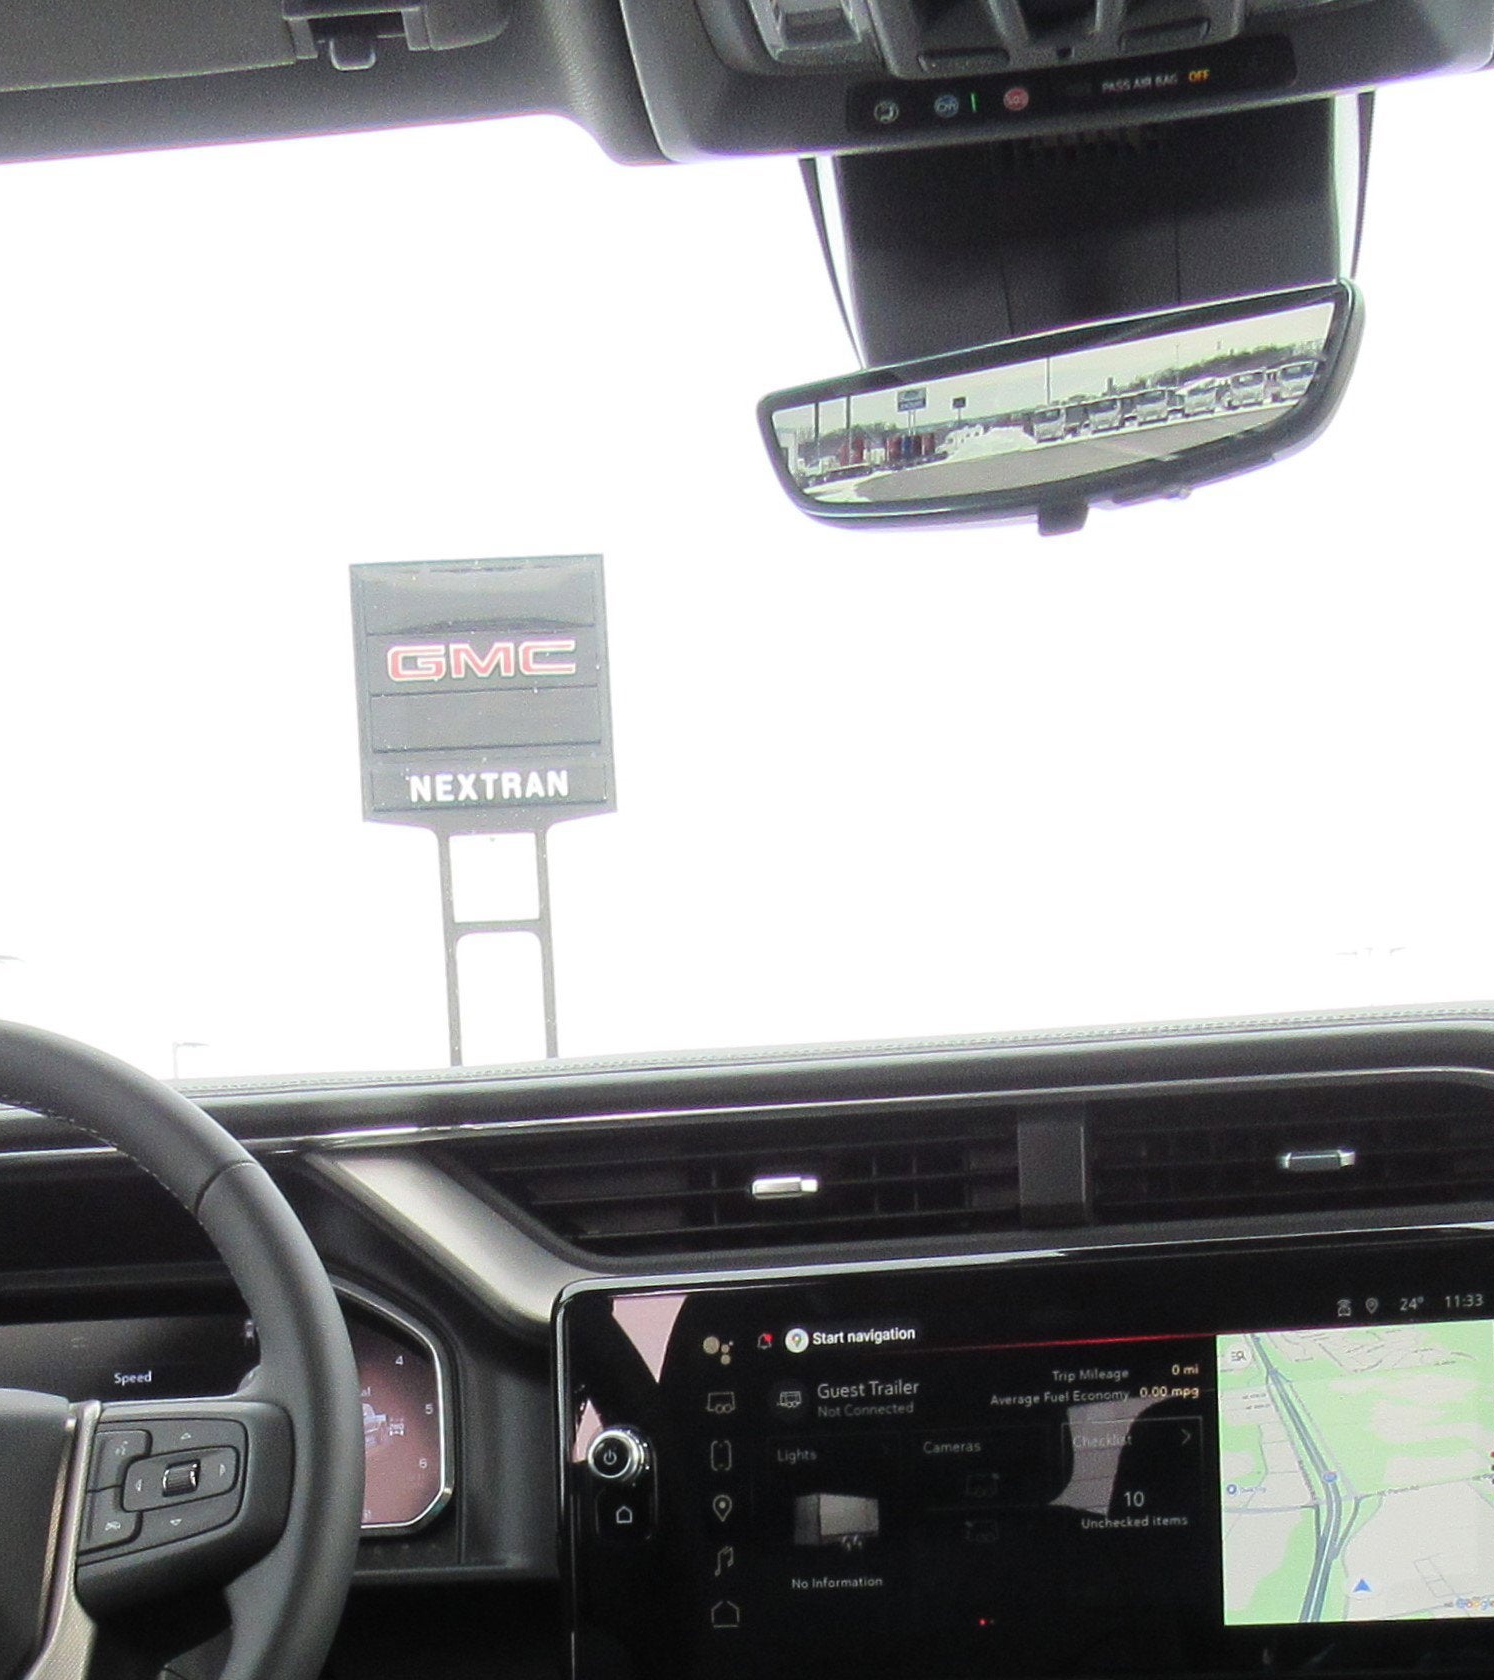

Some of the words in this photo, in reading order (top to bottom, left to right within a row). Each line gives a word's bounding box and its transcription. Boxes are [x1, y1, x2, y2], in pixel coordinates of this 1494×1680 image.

[1189, 69, 1210, 82] OFF
[386, 638, 577, 682] GMC
[409, 770, 569, 802] NEXTRAN
[1445, 1294, 1484, 1308] 11:33
[812, 1331, 844, 1345] Start
[847, 1327, 916, 1344] navigation
[395, 1356, 404, 1366] 4
[114, 1371, 152, 1386] Speed
[1053, 1370, 1075, 1382] Trip
[1079, 1368, 1129, 1382] Mileage
[1172, 1364, 1180, 1375] 0
[1183, 1363, 1199, 1375] mi
[817, 1383, 865, 1399] Guest
[869, 1379, 920, 1396] Trailer
[990, 1394, 1040, 1409] Average
[1044, 1391, 1069, 1402] Fuel
[1073, 1388, 1130, 1403] Economy
[1139, 1386, 1167, 1398] 0.00
[1171, 1386, 1200, 1400] mpg
[425, 1403, 434, 1415] 5
[817, 1405, 842, 1417] Not
[844, 1402, 915, 1416] Connected
[923, 1441, 982, 1454] Cameras
[419, 1459, 427, 1468] 6
[777, 1450, 817, 1464] Lights
[1124, 1491, 1145, 1508] 10
[1081, 1514, 1150, 1530] Unchecked
[1152, 1515, 1189, 1527] items
[791, 1578, 809, 1589] No
[812, 1576, 883, 1588] Information
